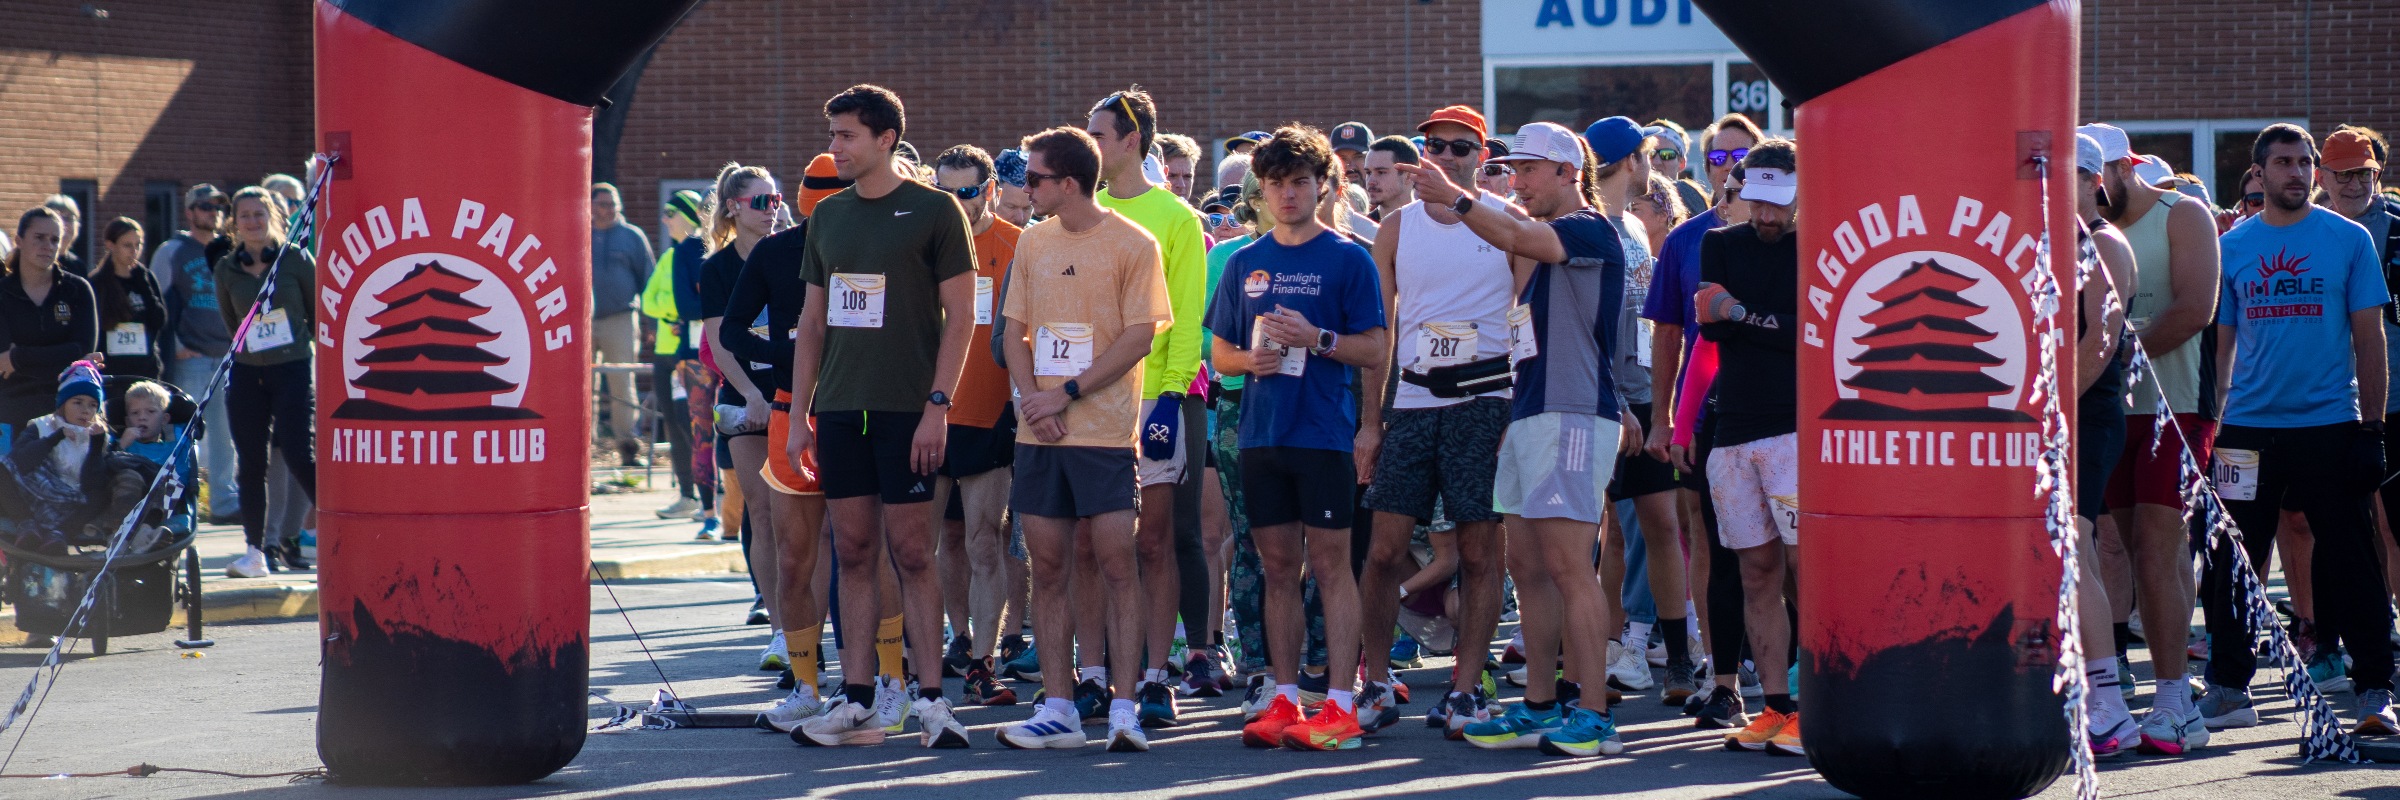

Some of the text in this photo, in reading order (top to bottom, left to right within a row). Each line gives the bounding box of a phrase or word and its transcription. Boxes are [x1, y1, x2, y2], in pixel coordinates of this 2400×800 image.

[1730, 80, 1767, 112] 36
[319, 197, 572, 351] PAGODA PACERS
[1274, 272, 1322, 285] Sunlight
[1804, 194, 1927, 348] PAGODA
[1272, 284, 1320, 296] Financial
[2273, 277, 2324, 296] ABLE
[842, 290, 867, 311] 108
[2248, 305, 2319, 318] DUATHLON
[117, 331, 136, 345] 293
[256, 322, 276, 339] 237
[1052, 339, 1070, 359] 12
[1430, 338, 1460, 358] 287
[332, 427, 545, 464] ATHLETIC CLUB
[1821, 429, 2040, 467] ATHLETIC CLUB
[2219, 464, 2241, 484] 106
[1786, 510, 1798, 530] 2
